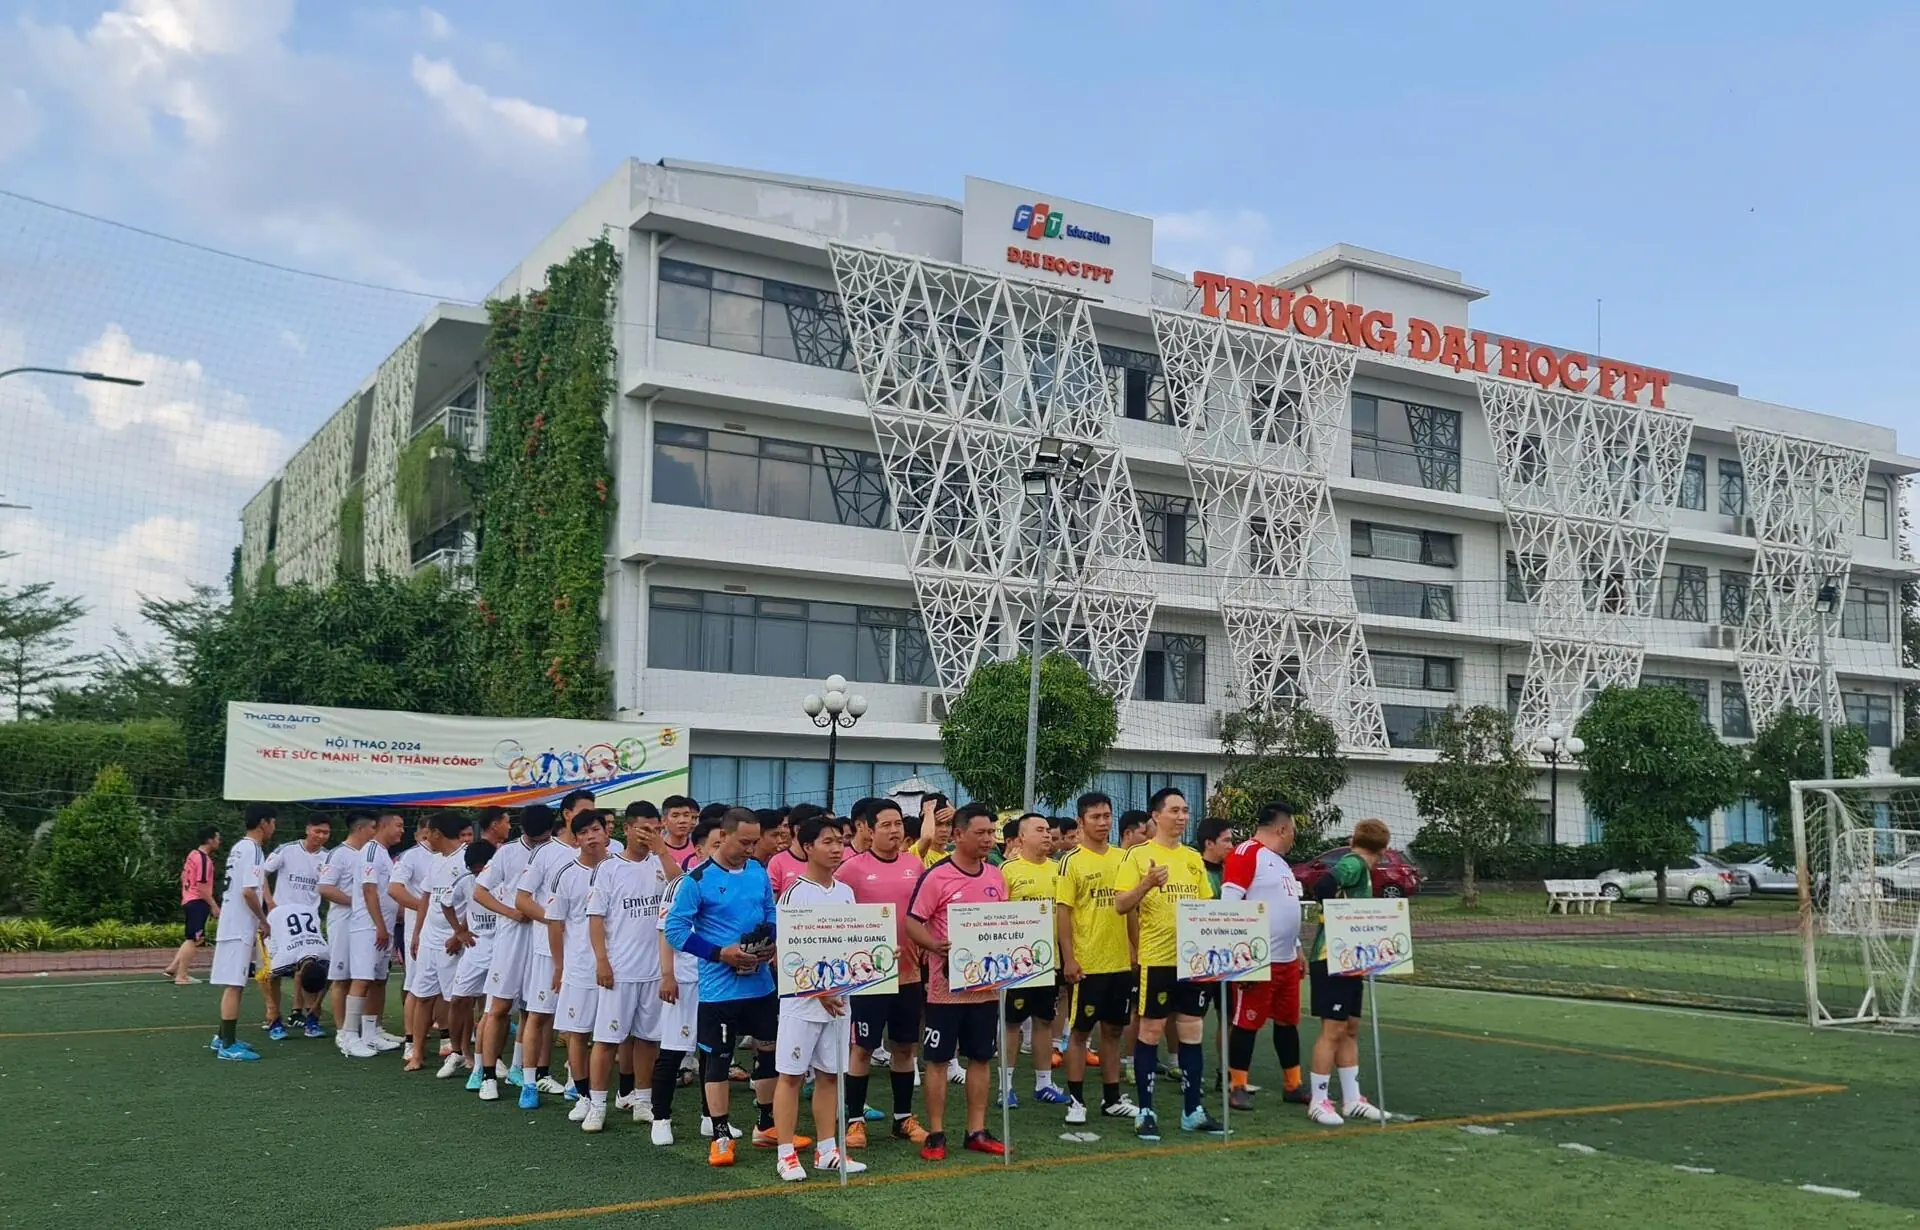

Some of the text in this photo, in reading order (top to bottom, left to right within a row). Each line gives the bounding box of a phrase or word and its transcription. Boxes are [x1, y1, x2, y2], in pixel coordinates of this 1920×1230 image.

[1014, 206, 1111, 245] FPT Education
[1007, 246, 1114, 285] ĐẠI HỌC FPT
[1193, 270, 1671, 409] TRƯỜNG ĐẠI HỌC FPT
[243, 712, 321, 724] THACO AUTO
[325, 736, 421, 751] HỘI THAO 2024
[321, 751, 360, 763] MẠNH
[397, 753, 440, 765] THÀNH
[622, 895, 663, 910] Emirat
[630, 908, 641, 919] FLY
[286, 912, 318, 936] 26
[1231, 928, 1248, 936] LONG
[803, 935, 817, 944] SÓC
[847, 934, 863, 945] HẬU
[864, 935, 887, 943] GIANG
[993, 932, 1007, 942] BẠC
[1008, 931, 1025, 940] LIÊU
[1198, 990, 1206, 1008] 6
[720, 1022, 728, 1044] 1
[857, 1021, 869, 1038] 19
[923, 1026, 941, 1048] 79
